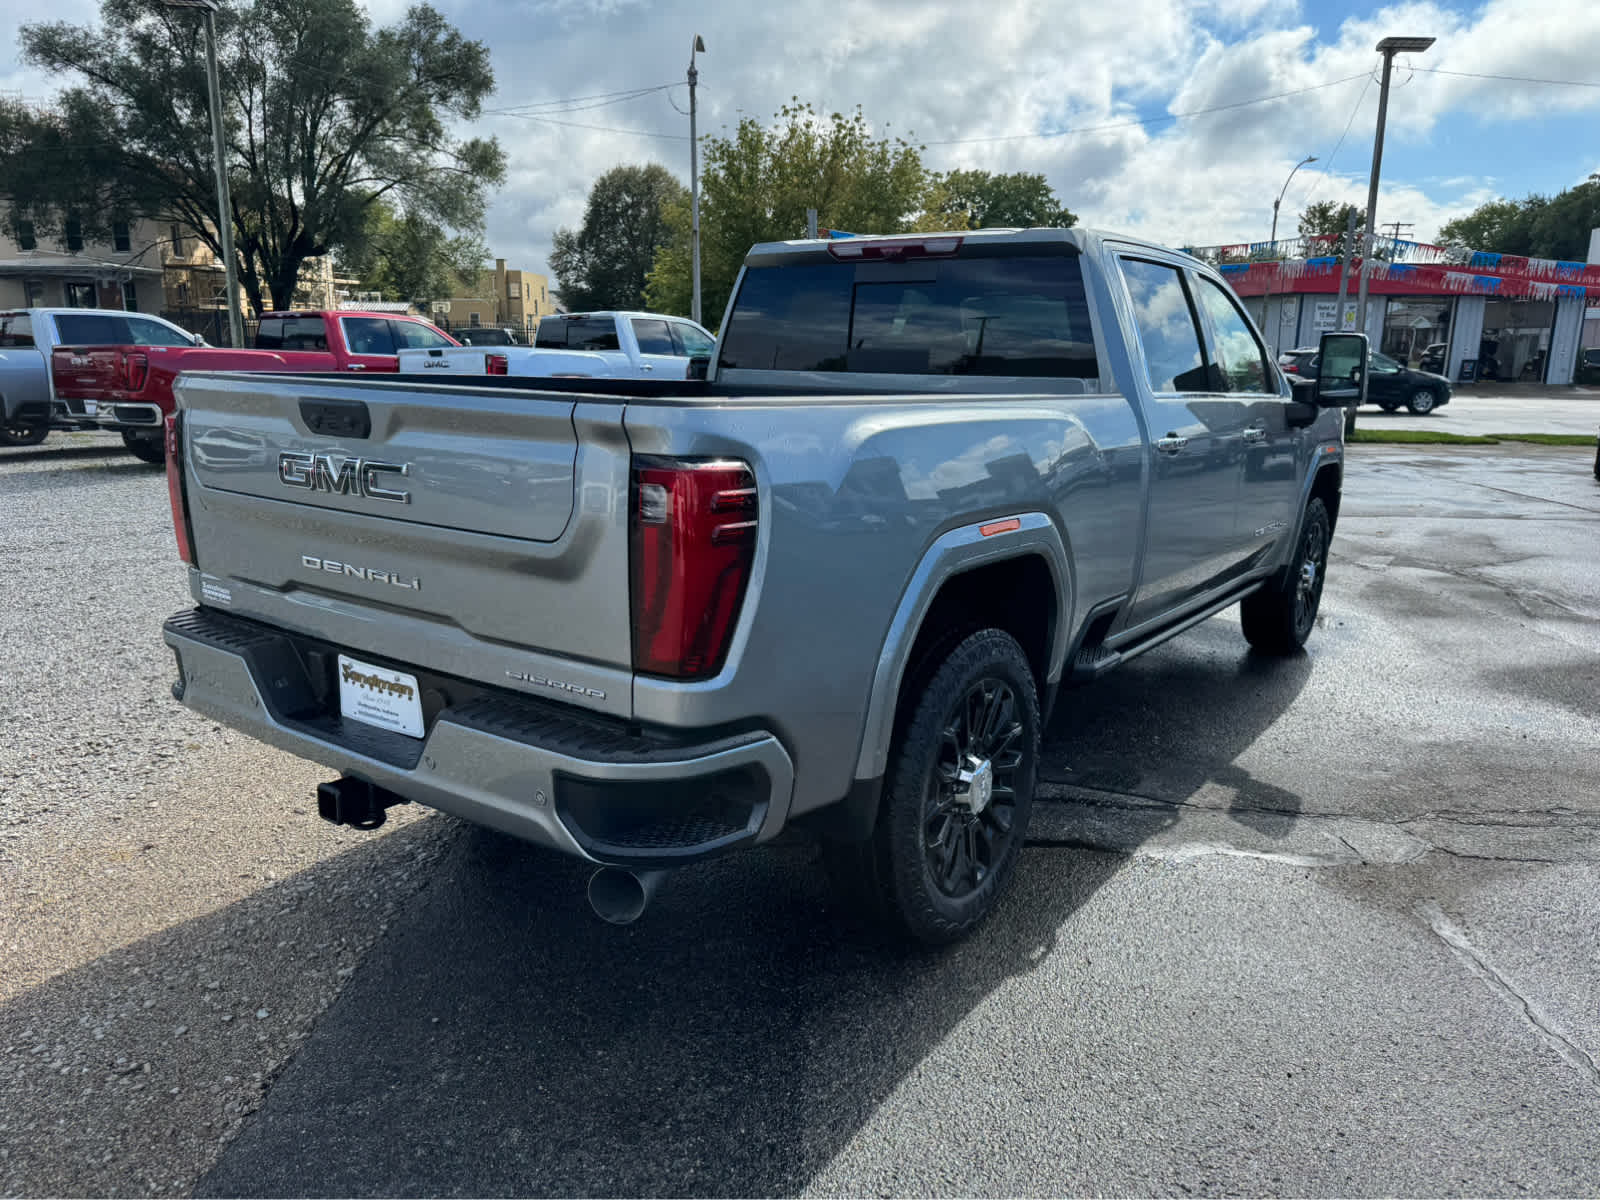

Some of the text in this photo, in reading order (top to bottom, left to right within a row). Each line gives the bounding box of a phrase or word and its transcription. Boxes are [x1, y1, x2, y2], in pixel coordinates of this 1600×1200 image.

[423, 359, 450, 369] GMC
[278, 450, 413, 504] GMC
[301, 555, 421, 592] DENALI
[505, 670, 607, 700] SIERRA
